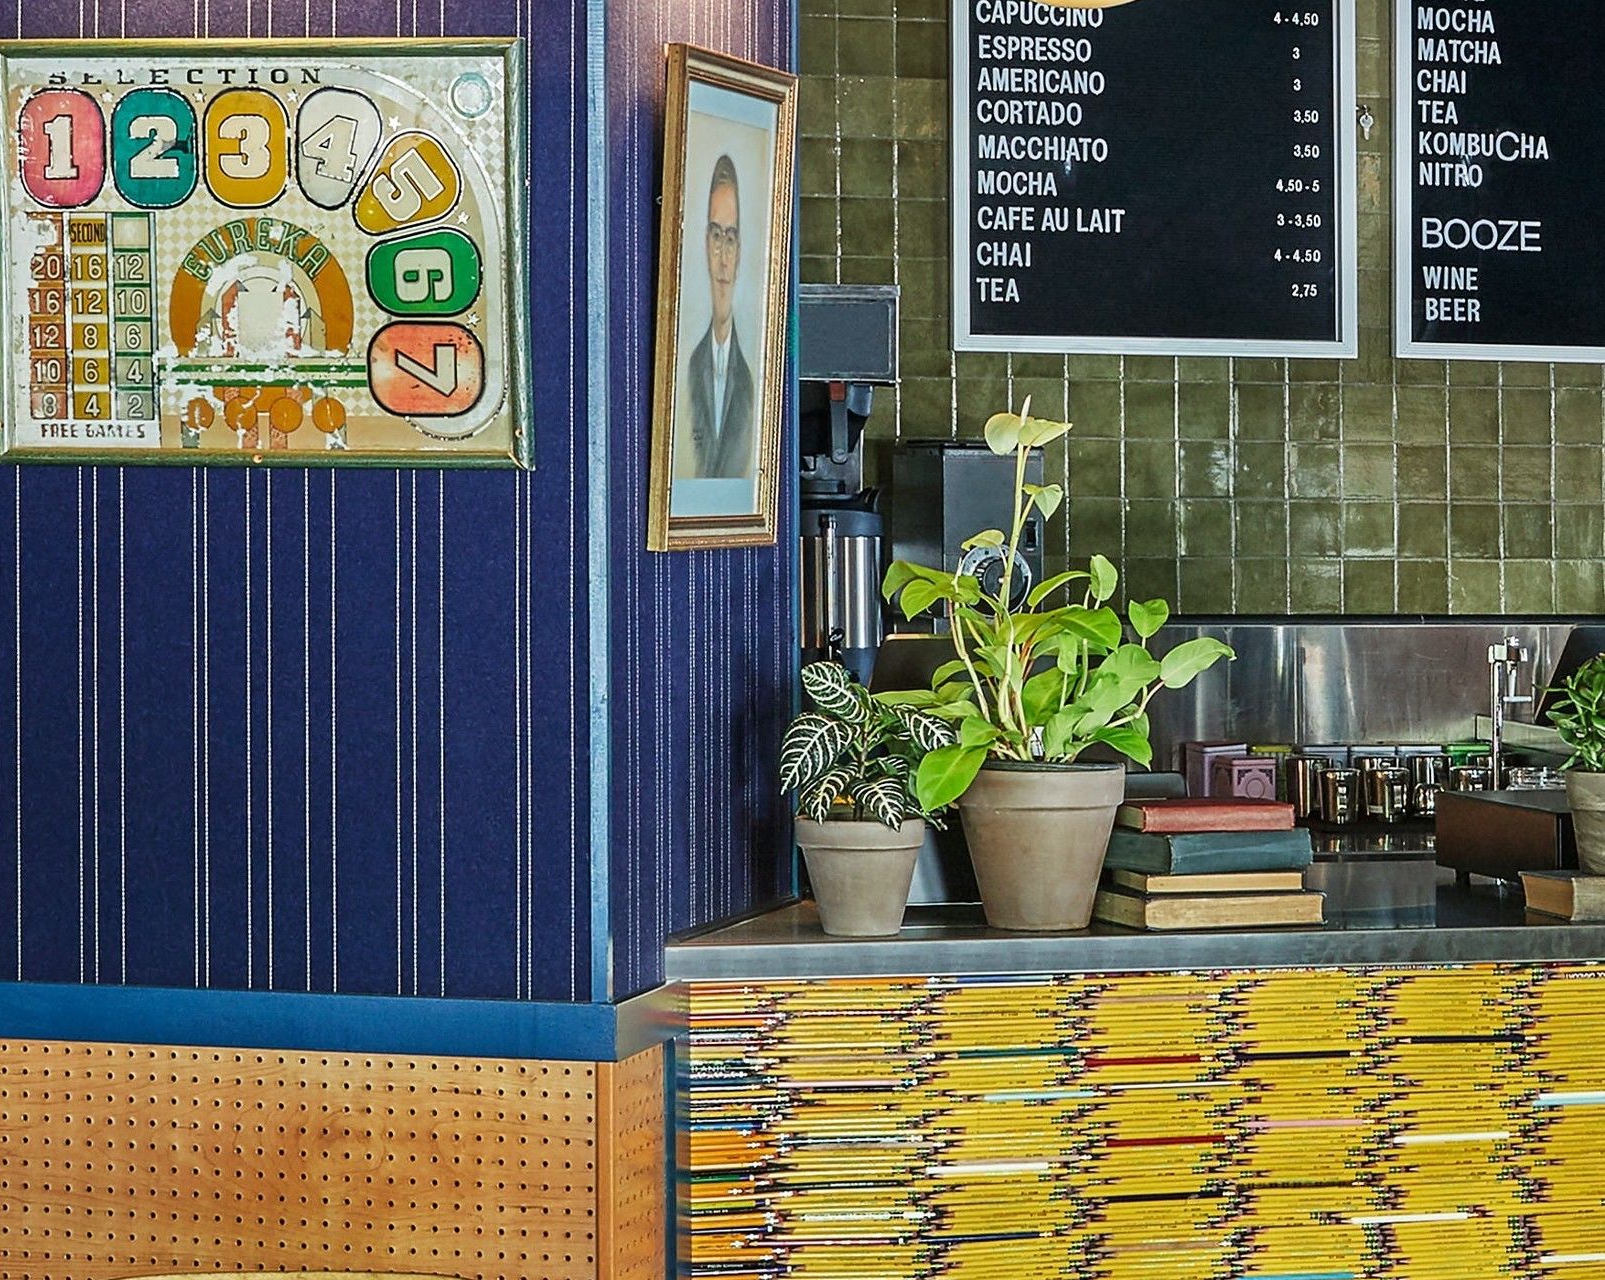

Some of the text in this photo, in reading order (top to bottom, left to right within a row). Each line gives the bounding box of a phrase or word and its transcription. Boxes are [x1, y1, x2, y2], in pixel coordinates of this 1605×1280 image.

[1417, 6, 1495, 34] MOCHA
[978, 34, 1301, 63] ESPRESSO 3
[1417, 37, 1502, 65] MATCHA
[48, 69, 321, 85] SELECTION
[977, 66, 1302, 96] AMERICANO 3
[1416, 68, 1467, 95] CHAI
[976, 99, 1319, 127] CORTADO 3.50
[1417, 99, 1459, 125] TEA
[978, 133, 1320, 163] MACCHIATO 3.50
[1418, 130, 1550, 162] KOMBUCHA
[977, 169, 1058, 197] MOCHA
[1418, 161, 1483, 188] NITRO
[70, 222, 106, 244] SECOND
[977, 205, 1035, 231] CAFE
[1040, 207, 1069, 233] AU
[1076, 207, 1126, 234] LAIT
[1421, 217, 1542, 252] BOOZE
[43, 114, 458, 398] 1 2 3 4 5 6 7
[183, 217, 333, 282] EUREKA
[976, 241, 1031, 268] CHAI
[31, 253, 144, 281] 20 16 12
[1422, 265, 1479, 292] WINE
[32, 289, 146, 315] 16 12 10
[975, 277, 1318, 303] TEA 2.75
[1425, 296, 1481, 322] BEER
[32, 323, 141, 350] 12 8 6
[34, 358, 143, 385] 10 6 4
[42, 393, 143, 418] 8 4 2
